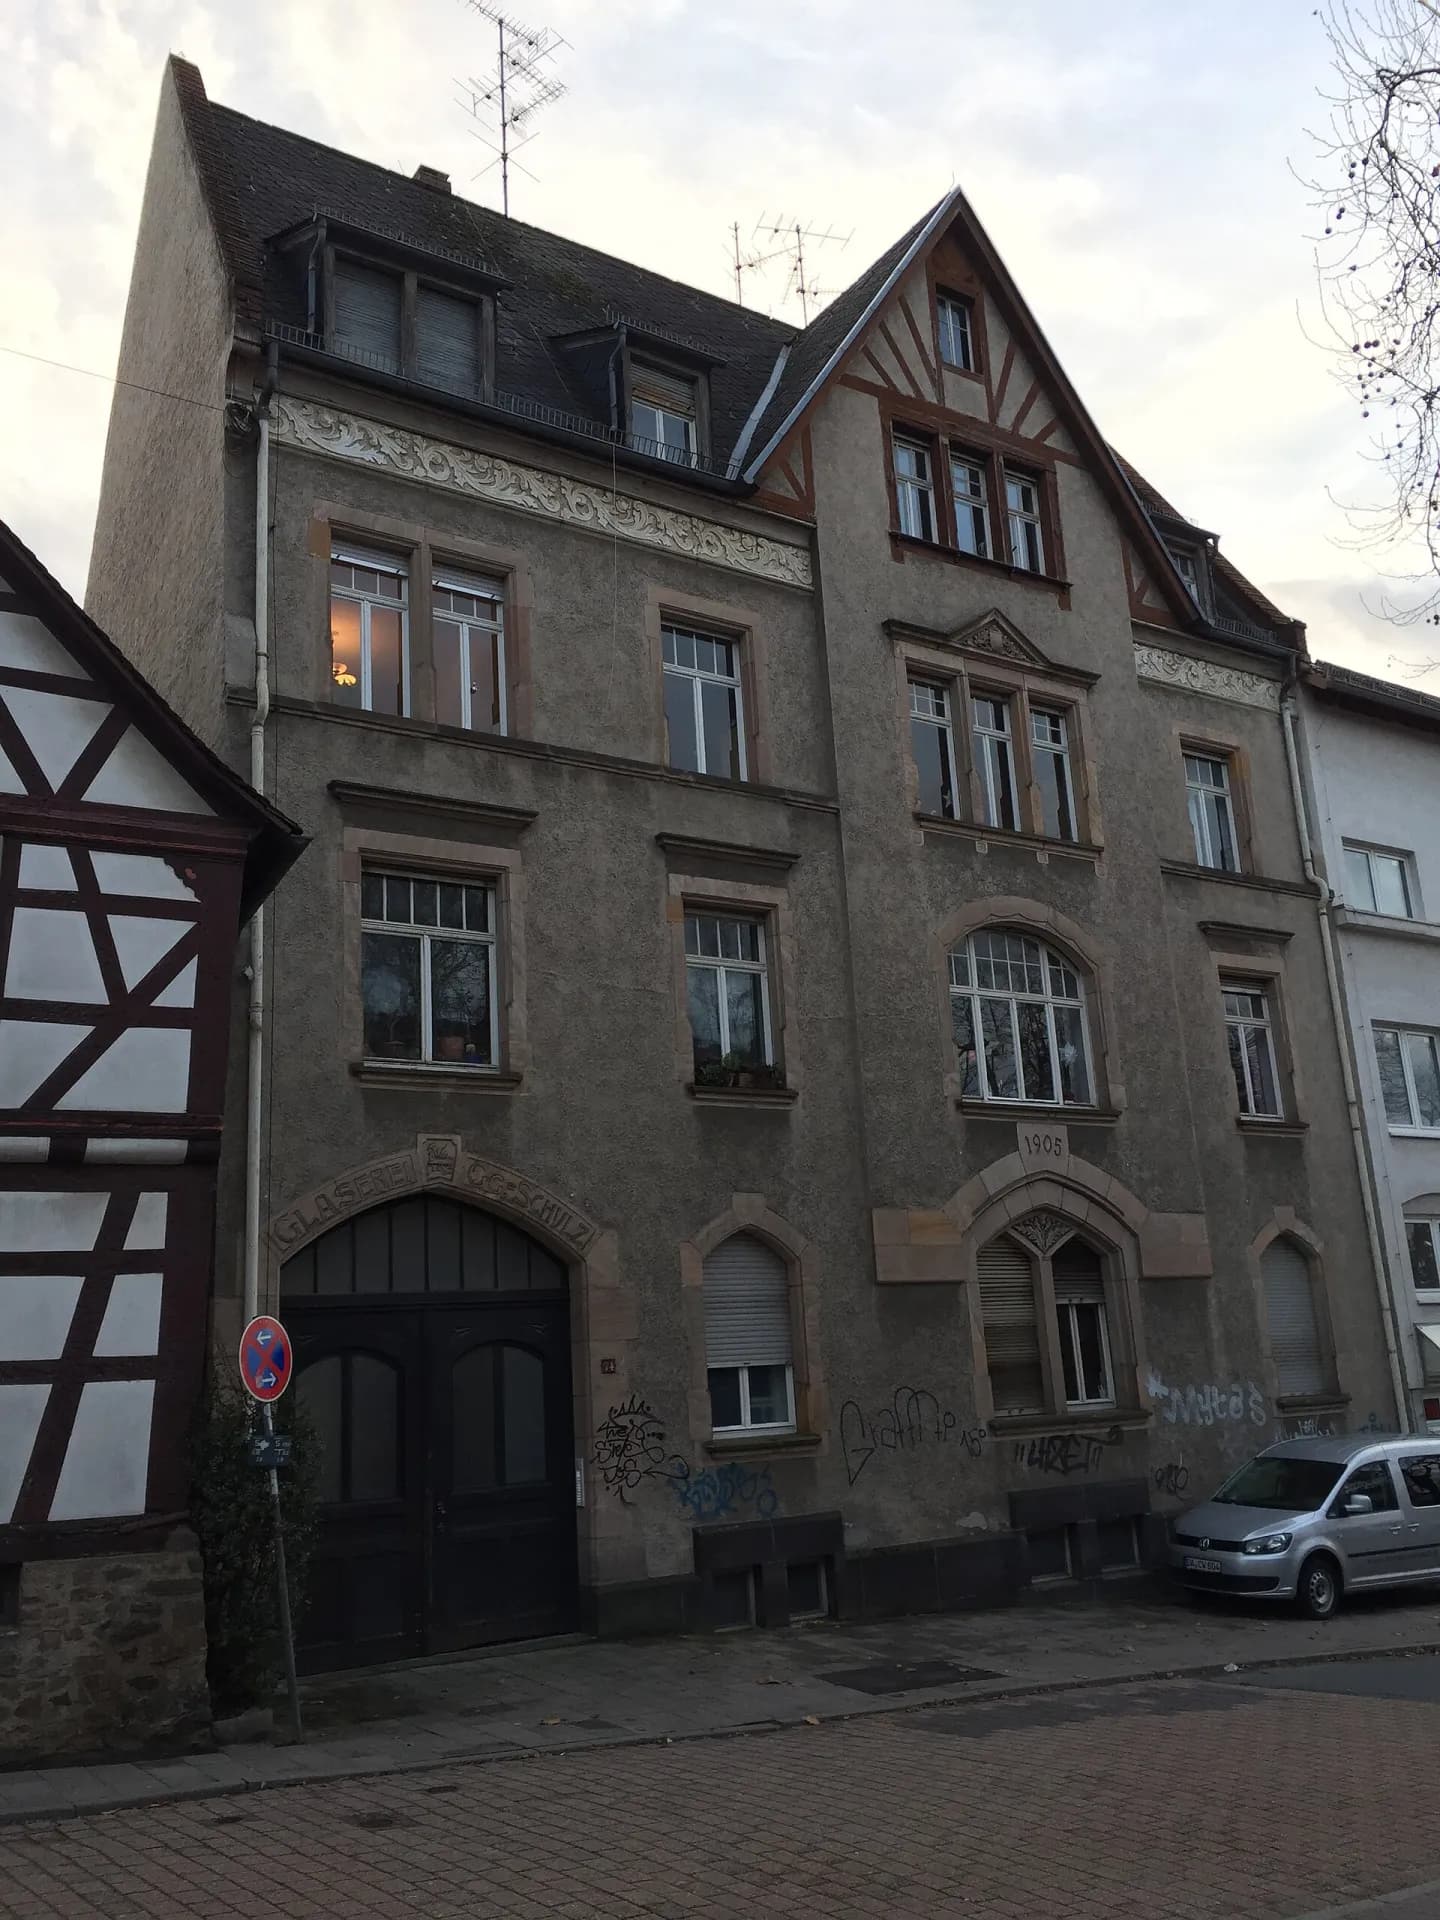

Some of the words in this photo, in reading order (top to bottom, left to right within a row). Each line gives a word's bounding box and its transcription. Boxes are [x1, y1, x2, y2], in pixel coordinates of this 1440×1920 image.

[1024, 1133, 1062, 1157] 1905
[273, 1160, 412, 1244] GLASEREI
[512, 1181, 588, 1241] SCHULZ
